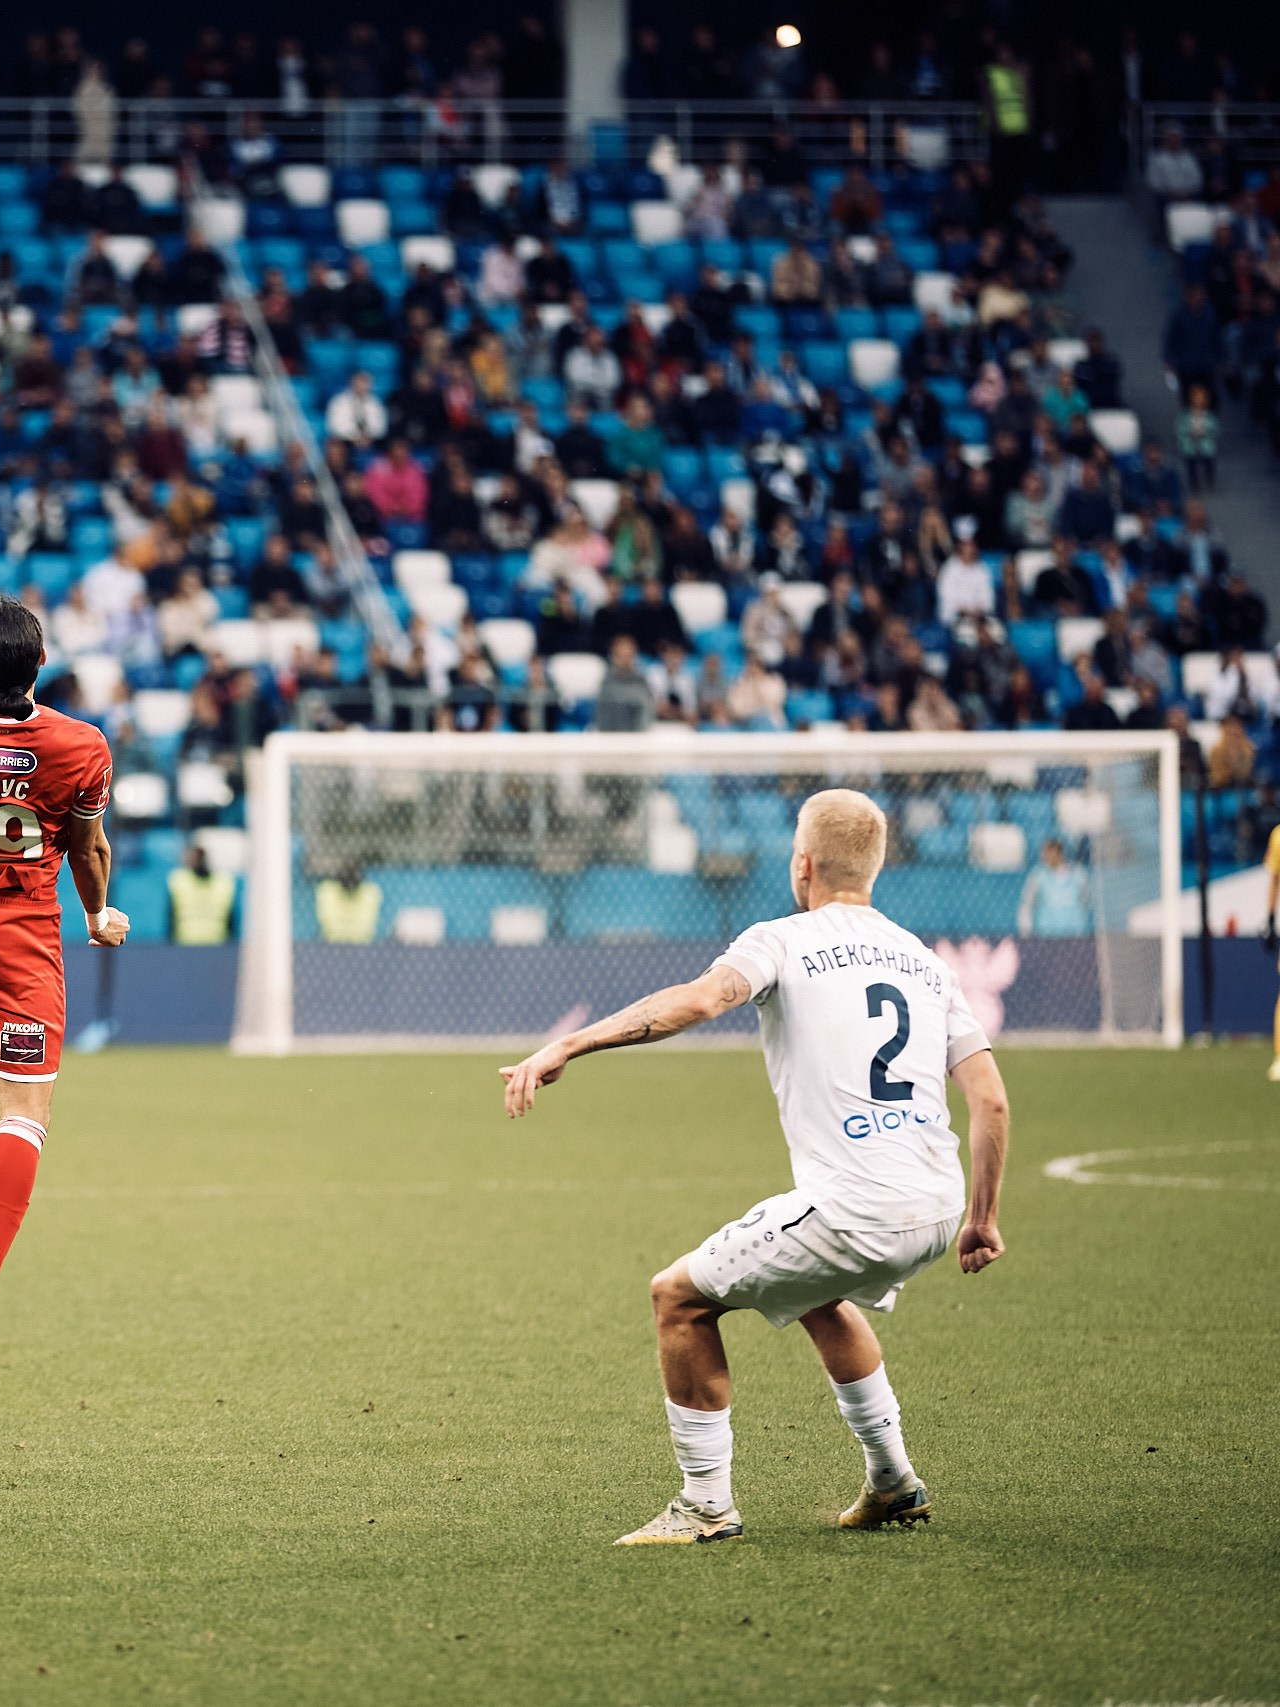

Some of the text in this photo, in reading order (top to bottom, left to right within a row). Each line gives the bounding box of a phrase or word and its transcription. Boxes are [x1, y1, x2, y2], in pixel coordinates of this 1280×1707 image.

[801, 943, 943, 995] АЛЕКСАНДРОВ
[2, 1021, 45, 1034] ЛУКОЙЛ
[865, 982, 916, 1102] 2
